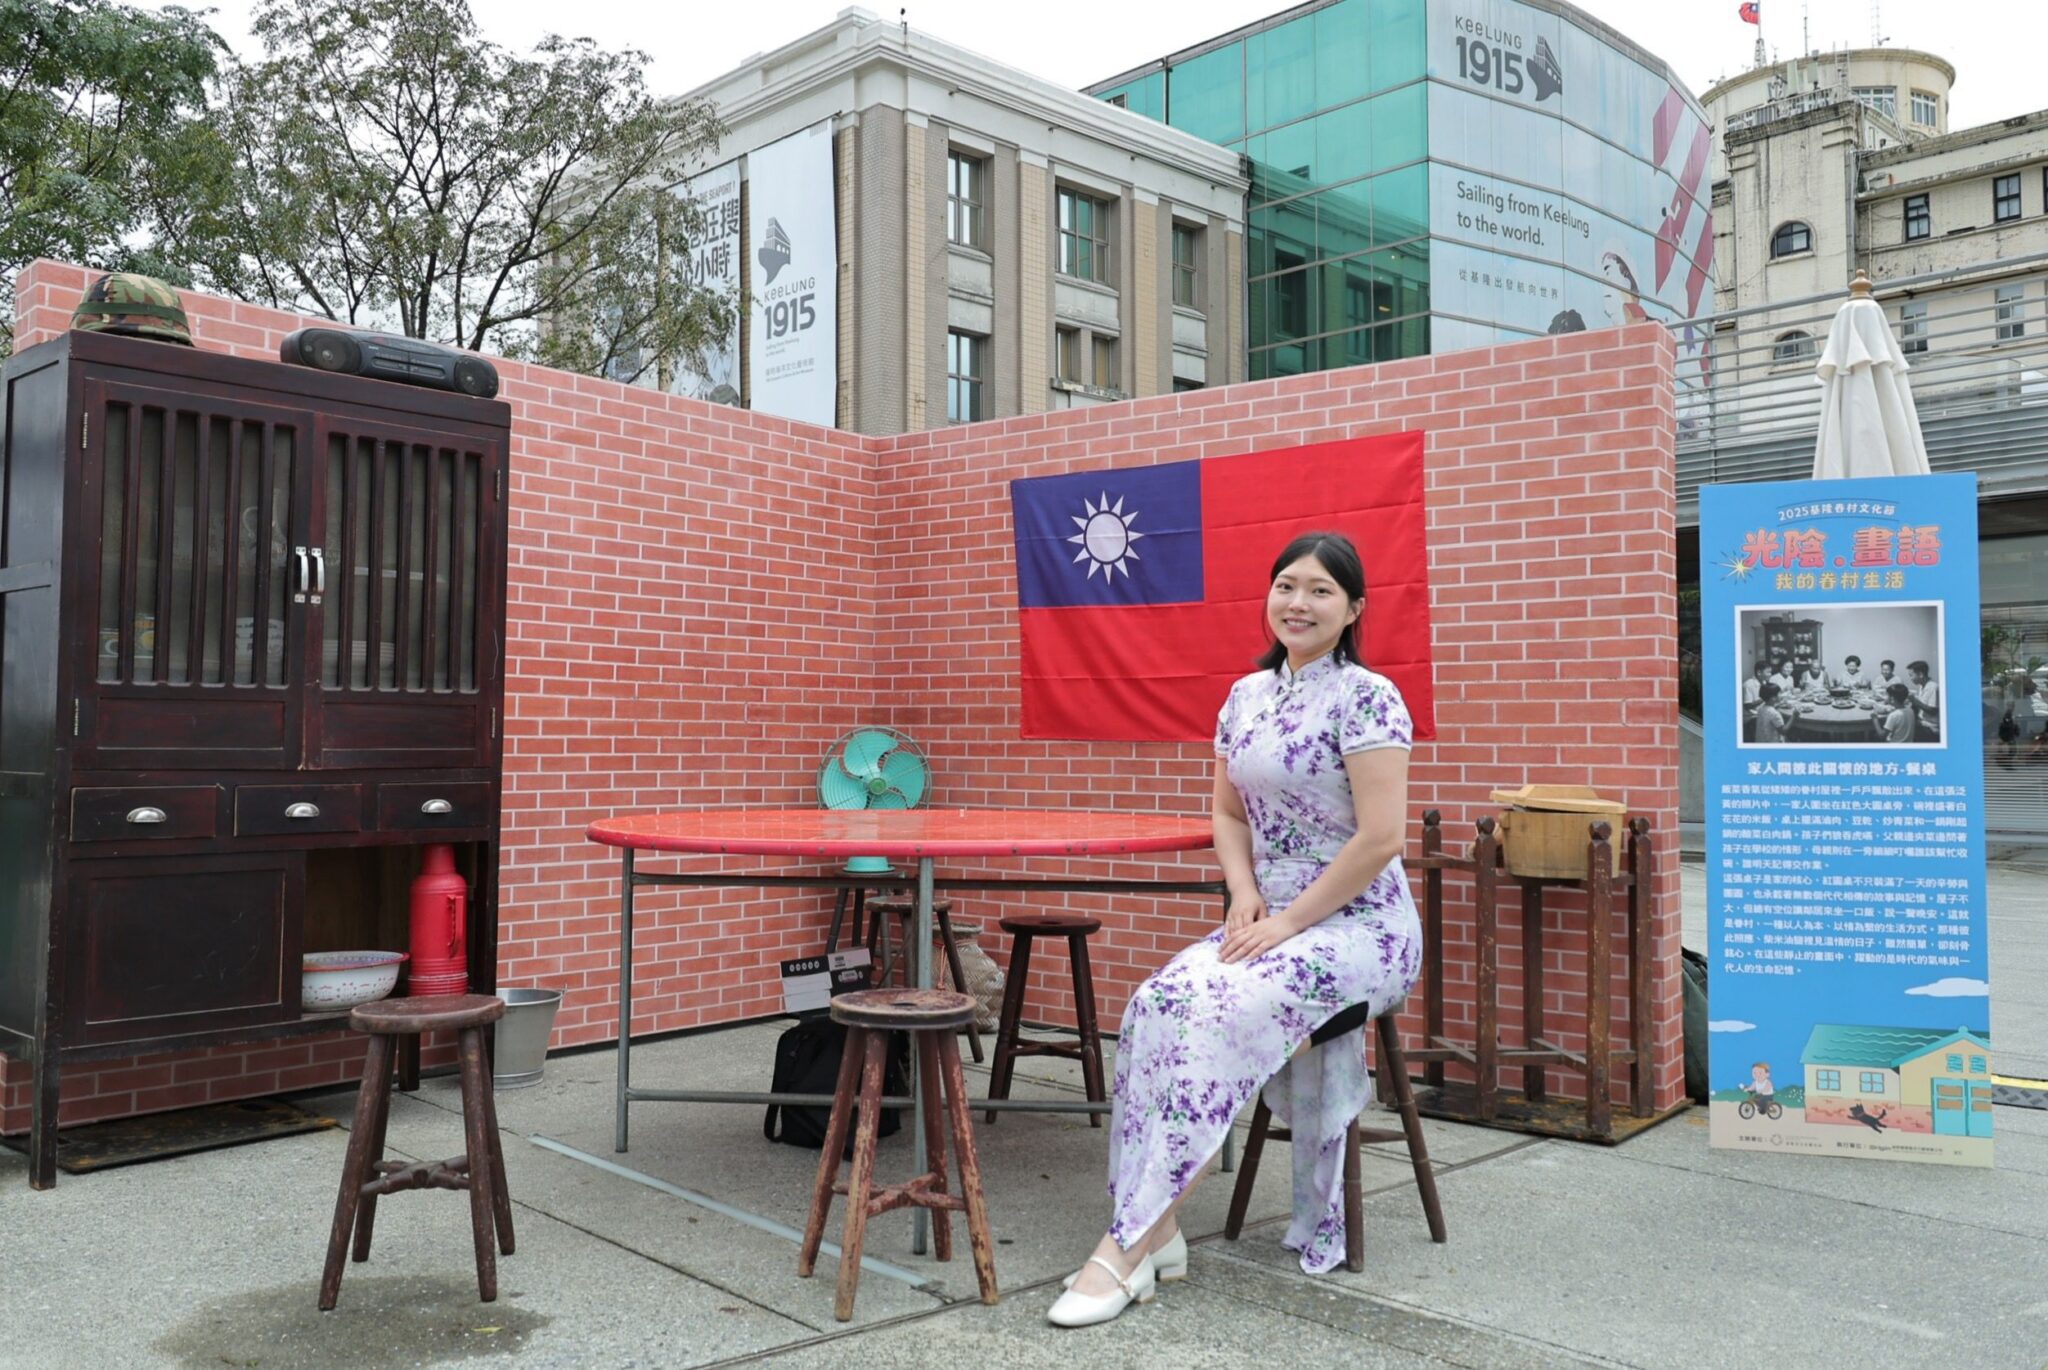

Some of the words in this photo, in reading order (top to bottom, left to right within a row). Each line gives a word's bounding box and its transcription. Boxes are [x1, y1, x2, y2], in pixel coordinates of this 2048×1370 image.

[1456, 35, 1523, 94] 1915
[1457, 181, 1504, 213] Sailing
[1508, 193, 1540, 217] from
[1544, 203, 1590, 238] Keelung
[1457, 212, 1472, 228] to
[1475, 214, 1498, 235] the
[1502, 225, 1545, 246] world.
[765, 293, 816, 340] 1915
[1776, 571, 1905, 591] 我的眷村生活
